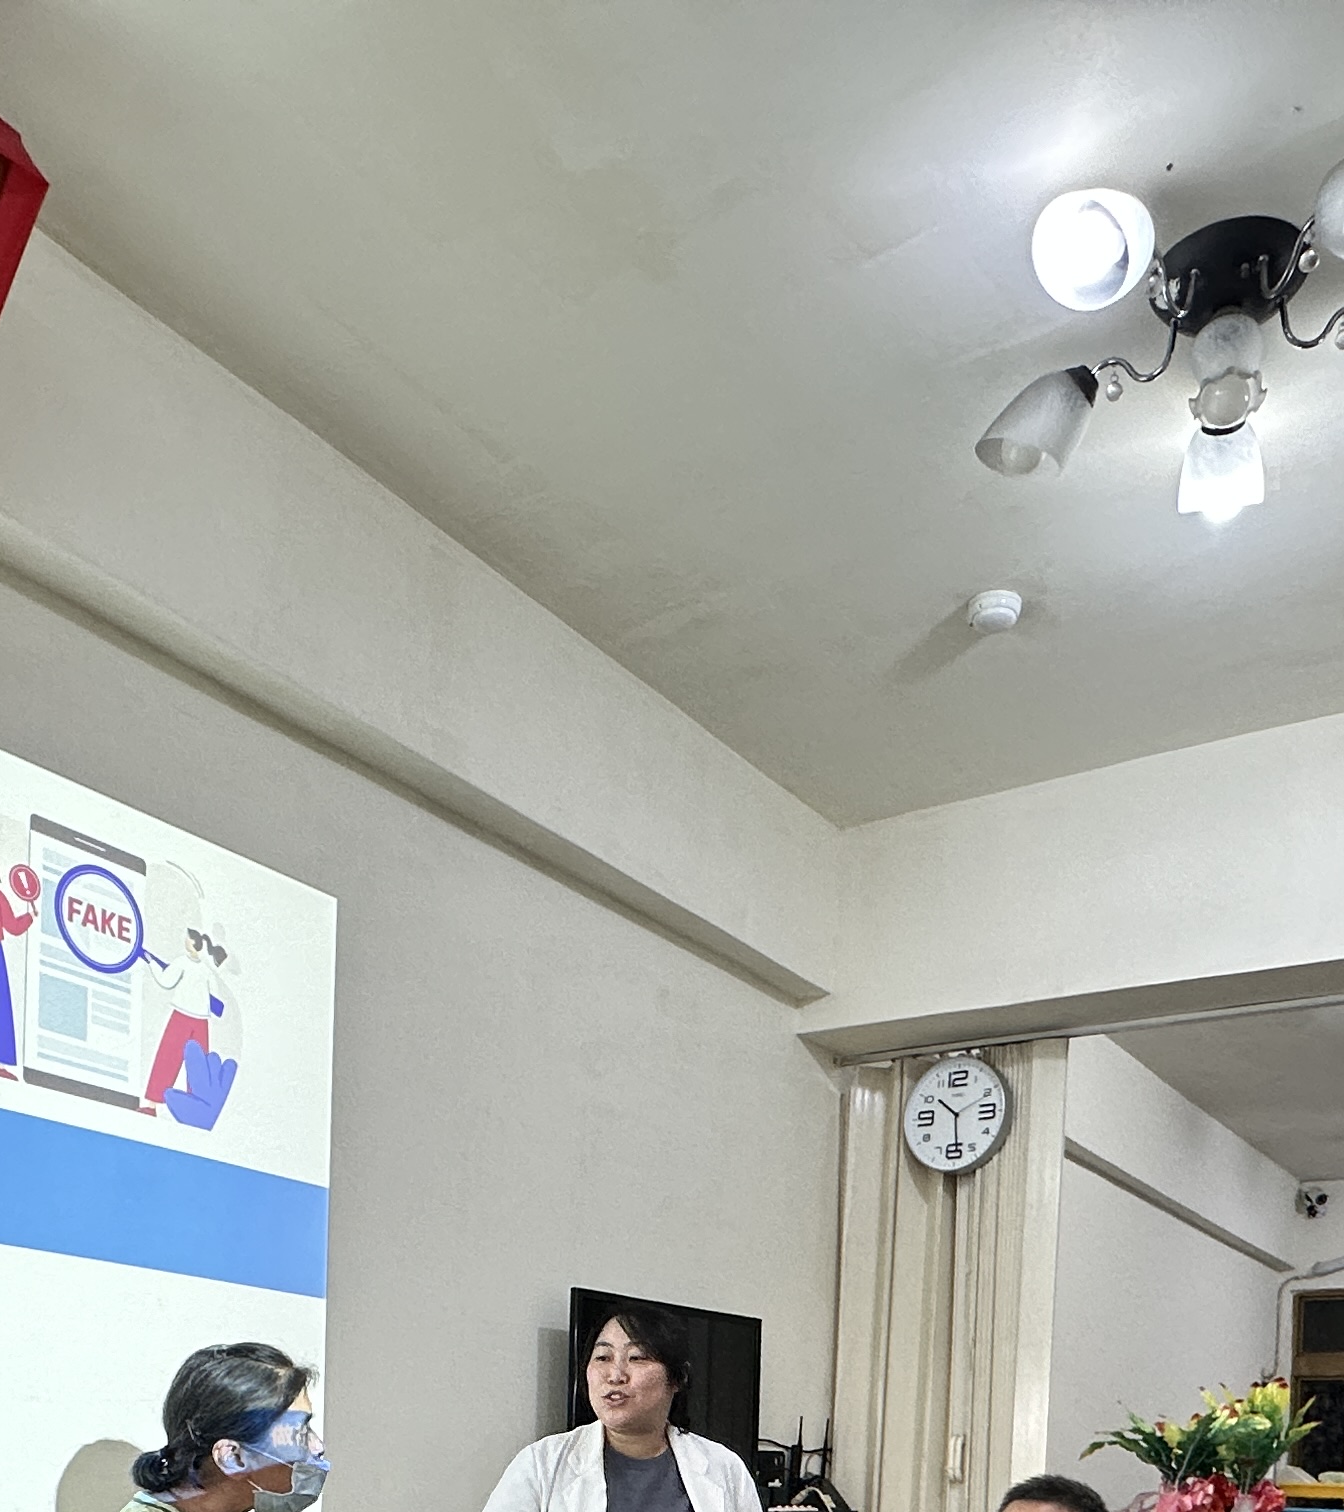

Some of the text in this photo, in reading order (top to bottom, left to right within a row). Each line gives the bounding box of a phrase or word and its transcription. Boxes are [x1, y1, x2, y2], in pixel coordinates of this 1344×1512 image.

[67, 896, 133, 944] FAKE
[948, 1070, 969, 1088] 12
[983, 1088, 992, 1097] 2
[924, 1095, 935, 1104] 10
[978, 1103, 996, 1120] 3
[917, 1110, 935, 1128] 9
[982, 1127, 990, 1135] 4
[922, 1134, 931, 1142] 8
[935, 1147, 942, 1155] 7
[945, 1143, 963, 1160] 6
[968, 1143, 976, 1152] 5
